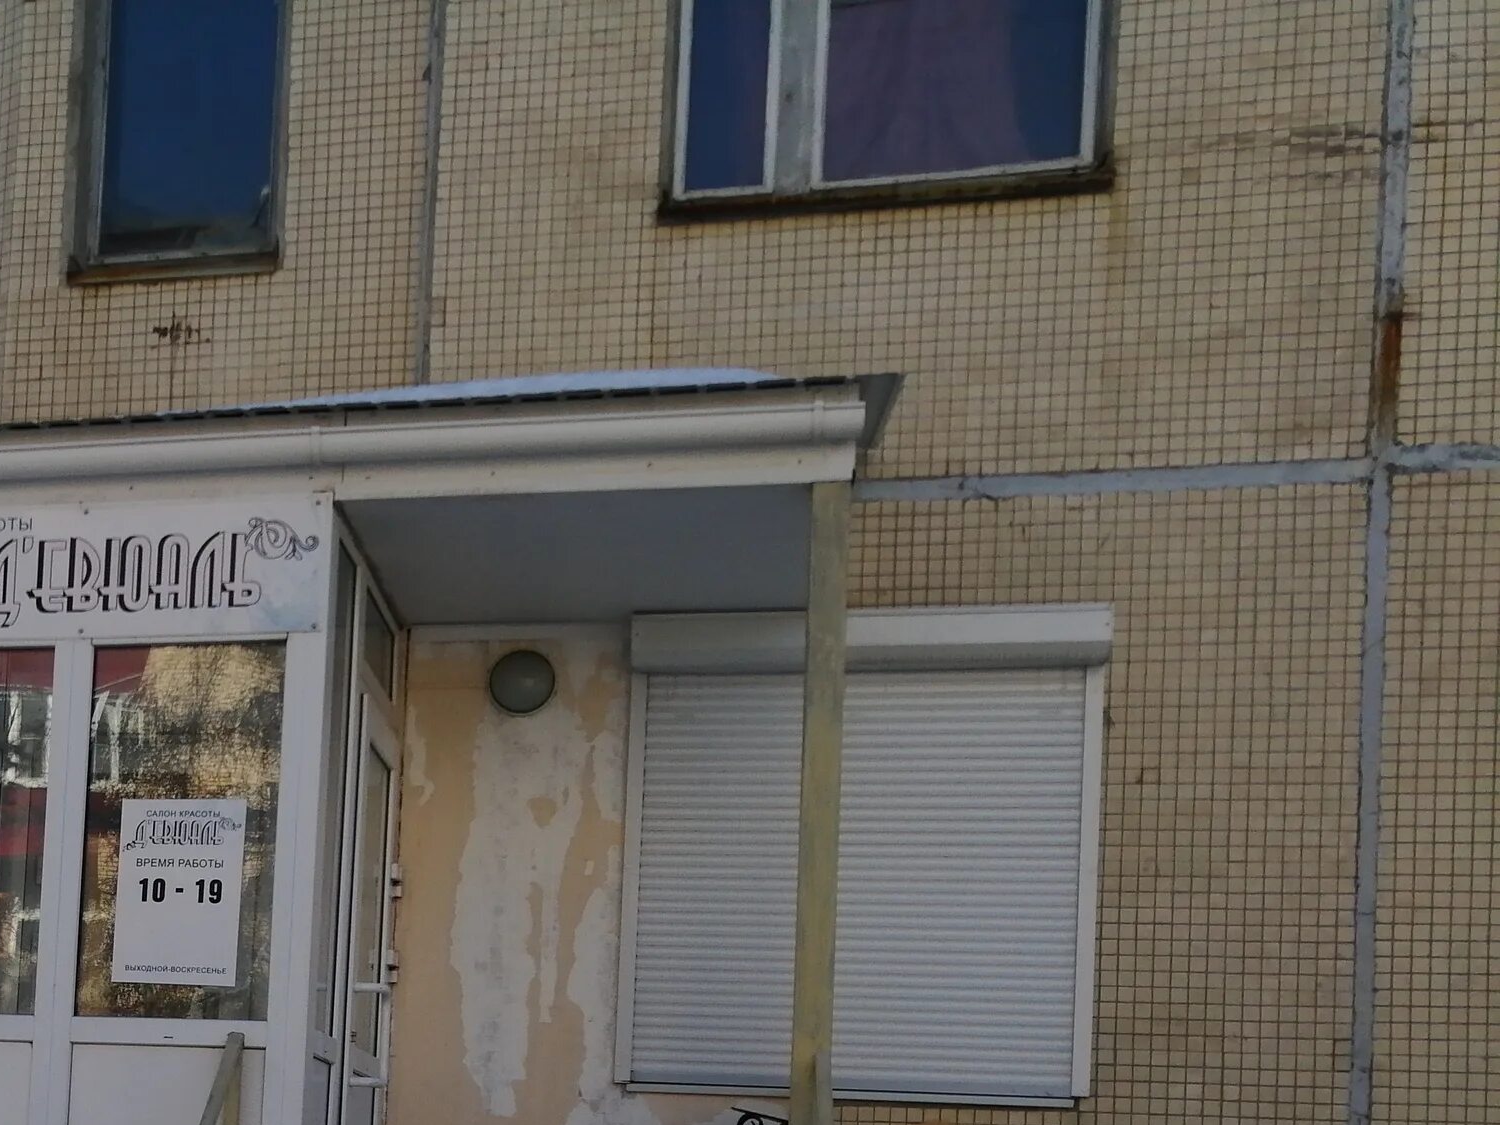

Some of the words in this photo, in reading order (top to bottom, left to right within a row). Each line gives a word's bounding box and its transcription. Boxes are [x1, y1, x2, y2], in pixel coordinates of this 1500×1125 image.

[146, 809, 177, 818] САЛОН
[179, 810, 221, 818] КРАСОТЫ
[135, 857, 175, 868] ВРЕМЯ
[178, 858, 224, 869] РАБОТЫ
[138, 877, 166, 903] 10
[195, 878, 223, 904] 19
